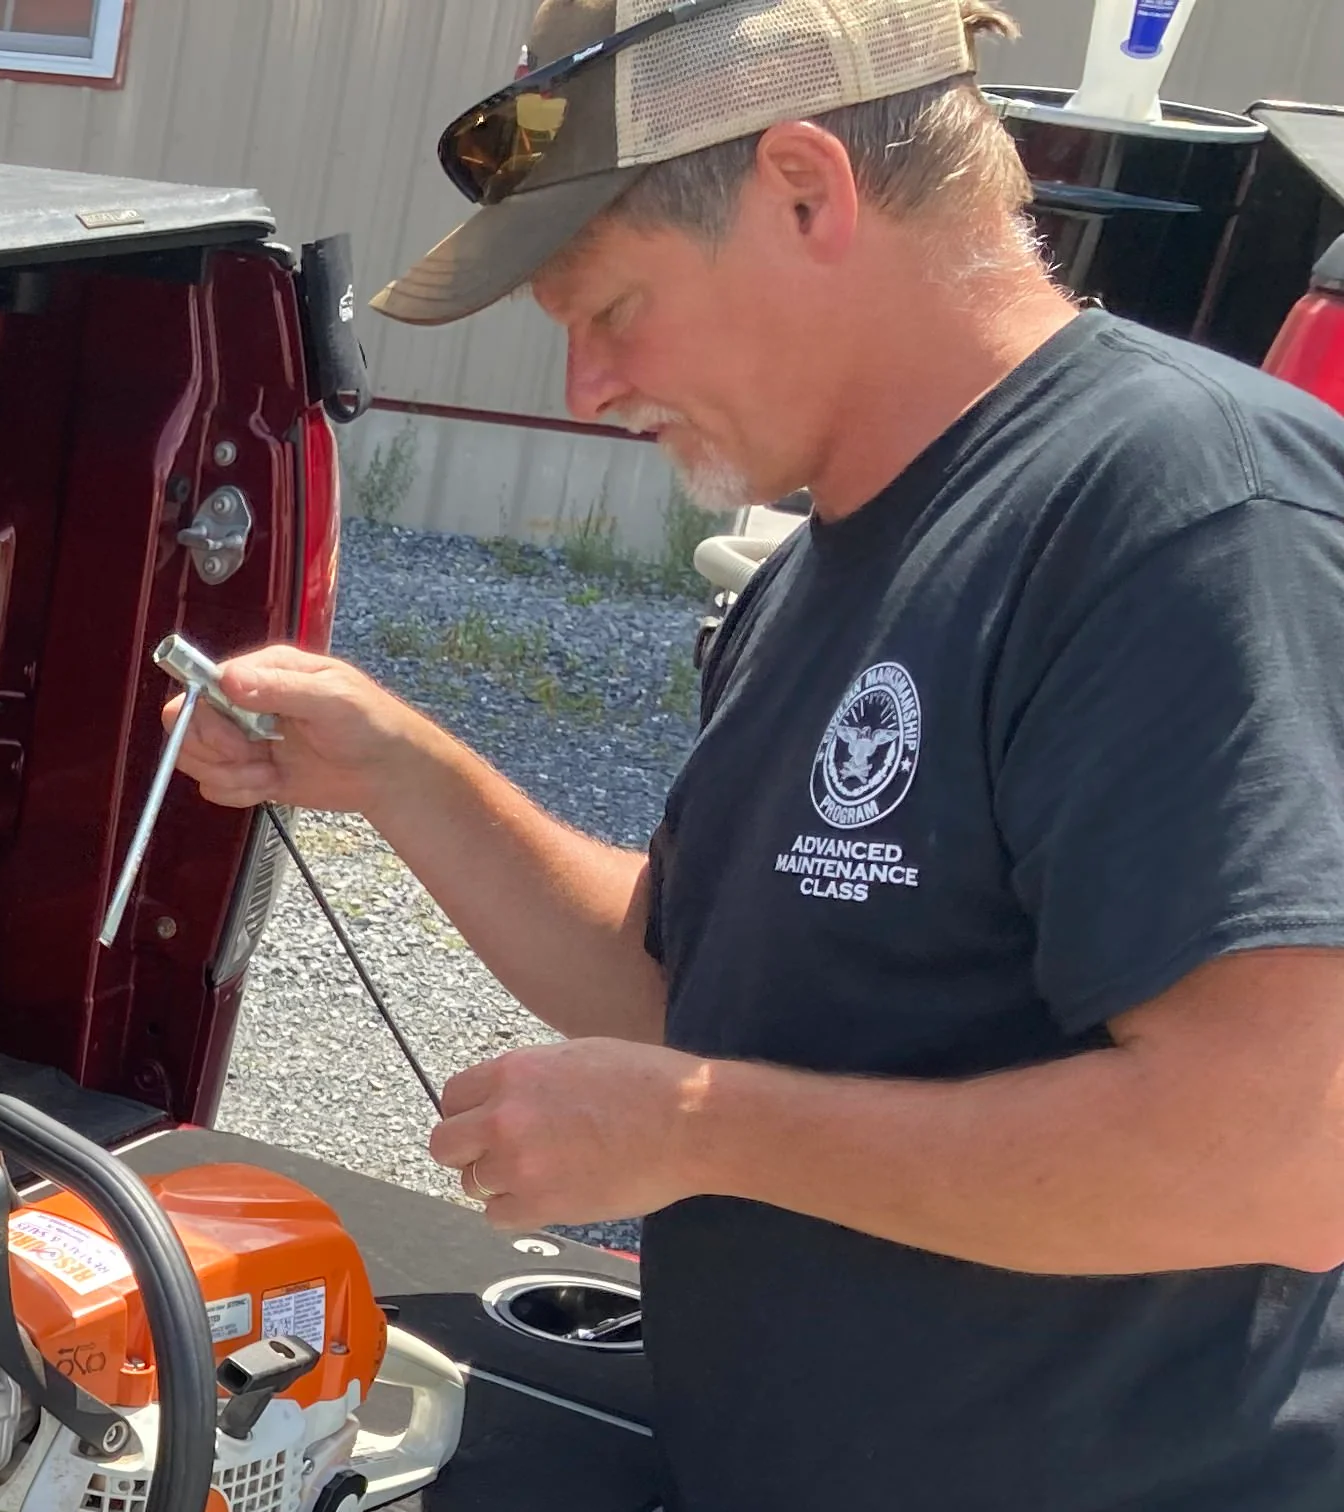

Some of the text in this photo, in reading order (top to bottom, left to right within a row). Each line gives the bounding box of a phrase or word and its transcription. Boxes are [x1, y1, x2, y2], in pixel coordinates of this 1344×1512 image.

[865, 667, 918, 751] MARKSMANSHIP
[819, 794, 880, 824] PROGRAM
[791, 834, 903, 863] ADVANCED
[774, 854, 919, 887] MAINTENANCE
[799, 877, 869, 902] CLASS
